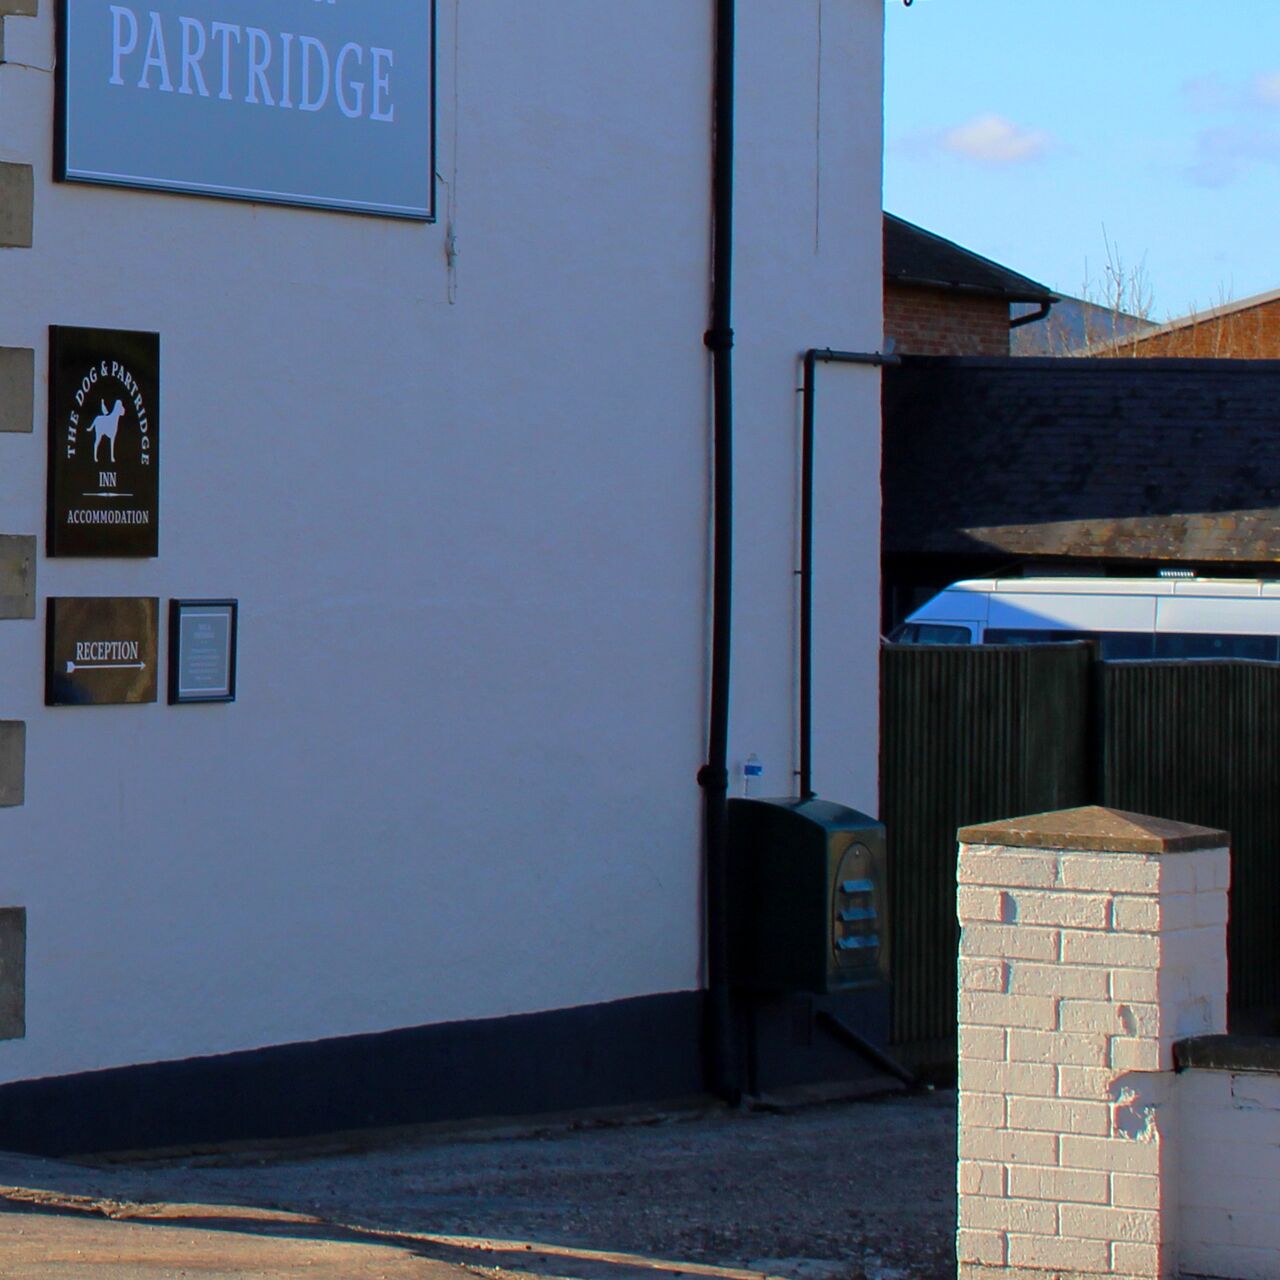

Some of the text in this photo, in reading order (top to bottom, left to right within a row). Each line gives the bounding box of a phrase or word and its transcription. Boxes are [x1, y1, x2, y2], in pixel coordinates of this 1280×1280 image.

[109, 5, 394, 122] PARTRIDGE
[67, 360, 150, 466] THE DOG & PARTRIDGE
[99, 471, 117, 488] INN
[67, 509, 149, 525] ACCOMMODATION
[76, 641, 138, 661] RECEPTION
